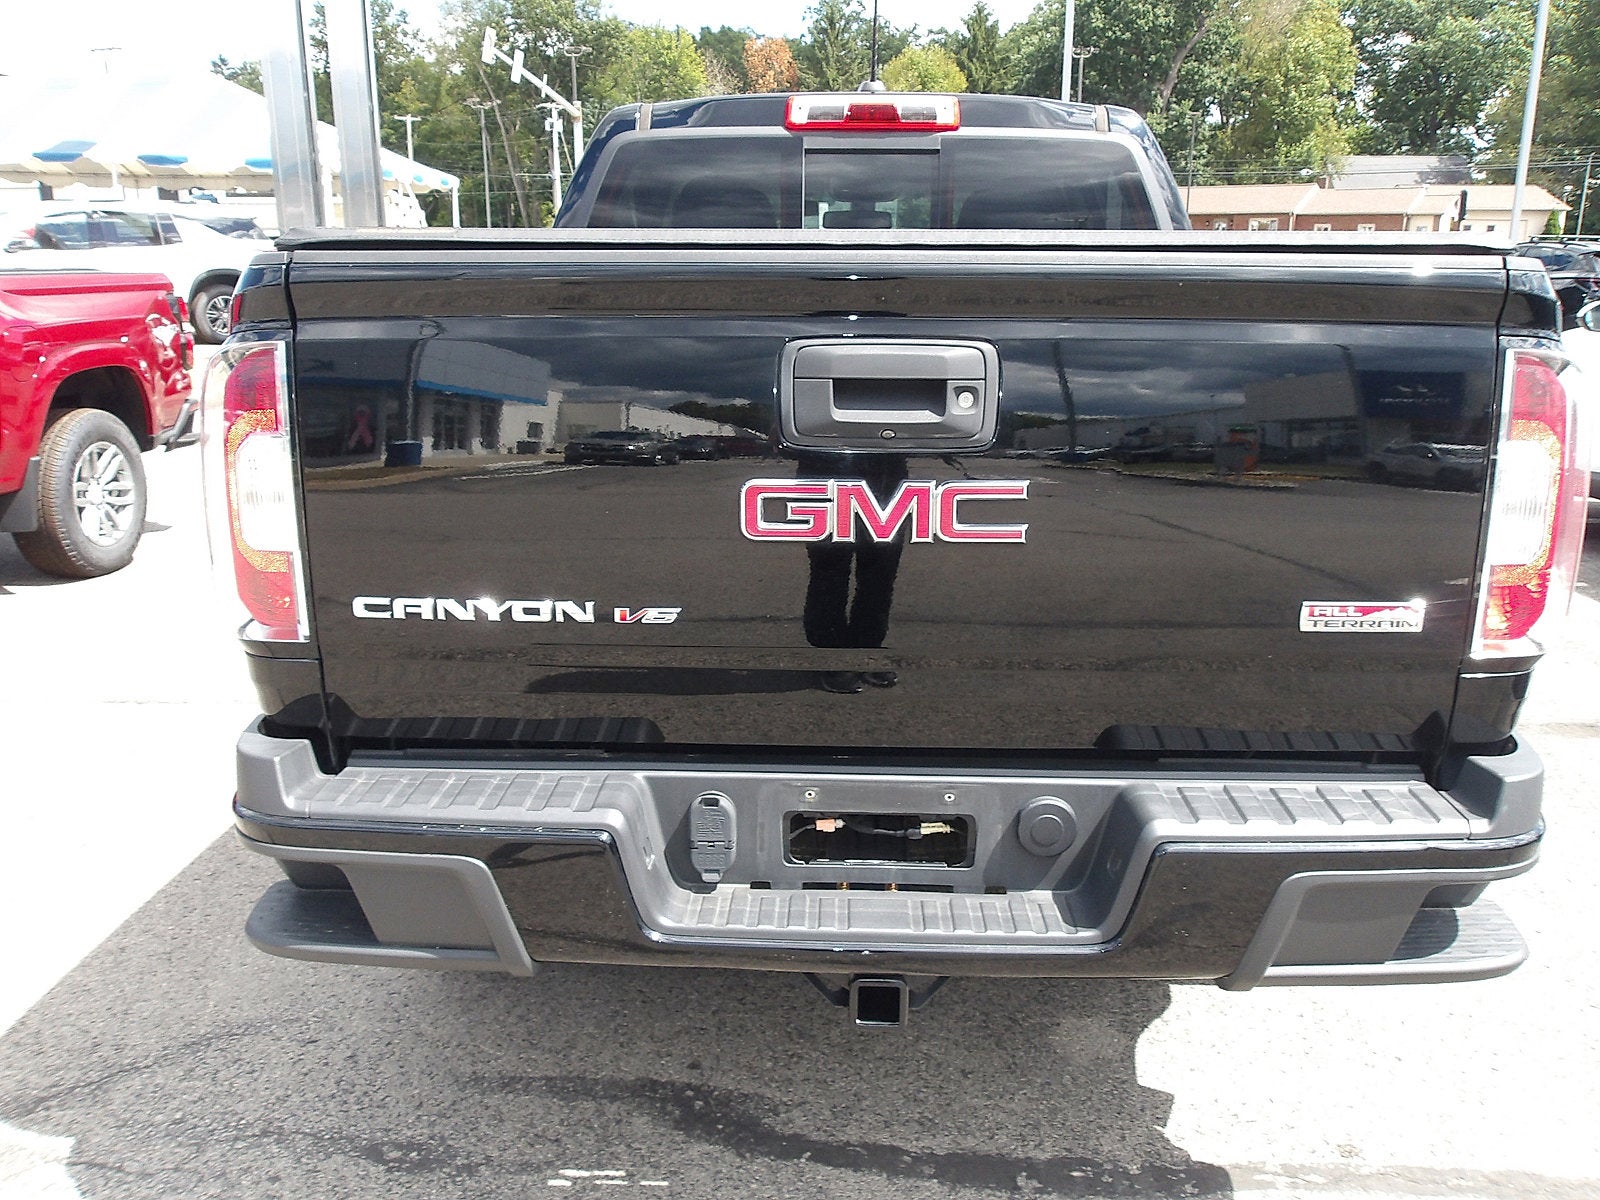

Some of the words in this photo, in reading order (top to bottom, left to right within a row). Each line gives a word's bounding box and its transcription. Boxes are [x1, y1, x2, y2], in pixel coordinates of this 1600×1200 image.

[740, 478, 1030, 543] GMC
[352, 596, 596, 623] CANYON
[613, 607, 682, 624] V6
[1310, 605, 1363, 617] ALL
[1307, 619, 1419, 629] TERRAIN
